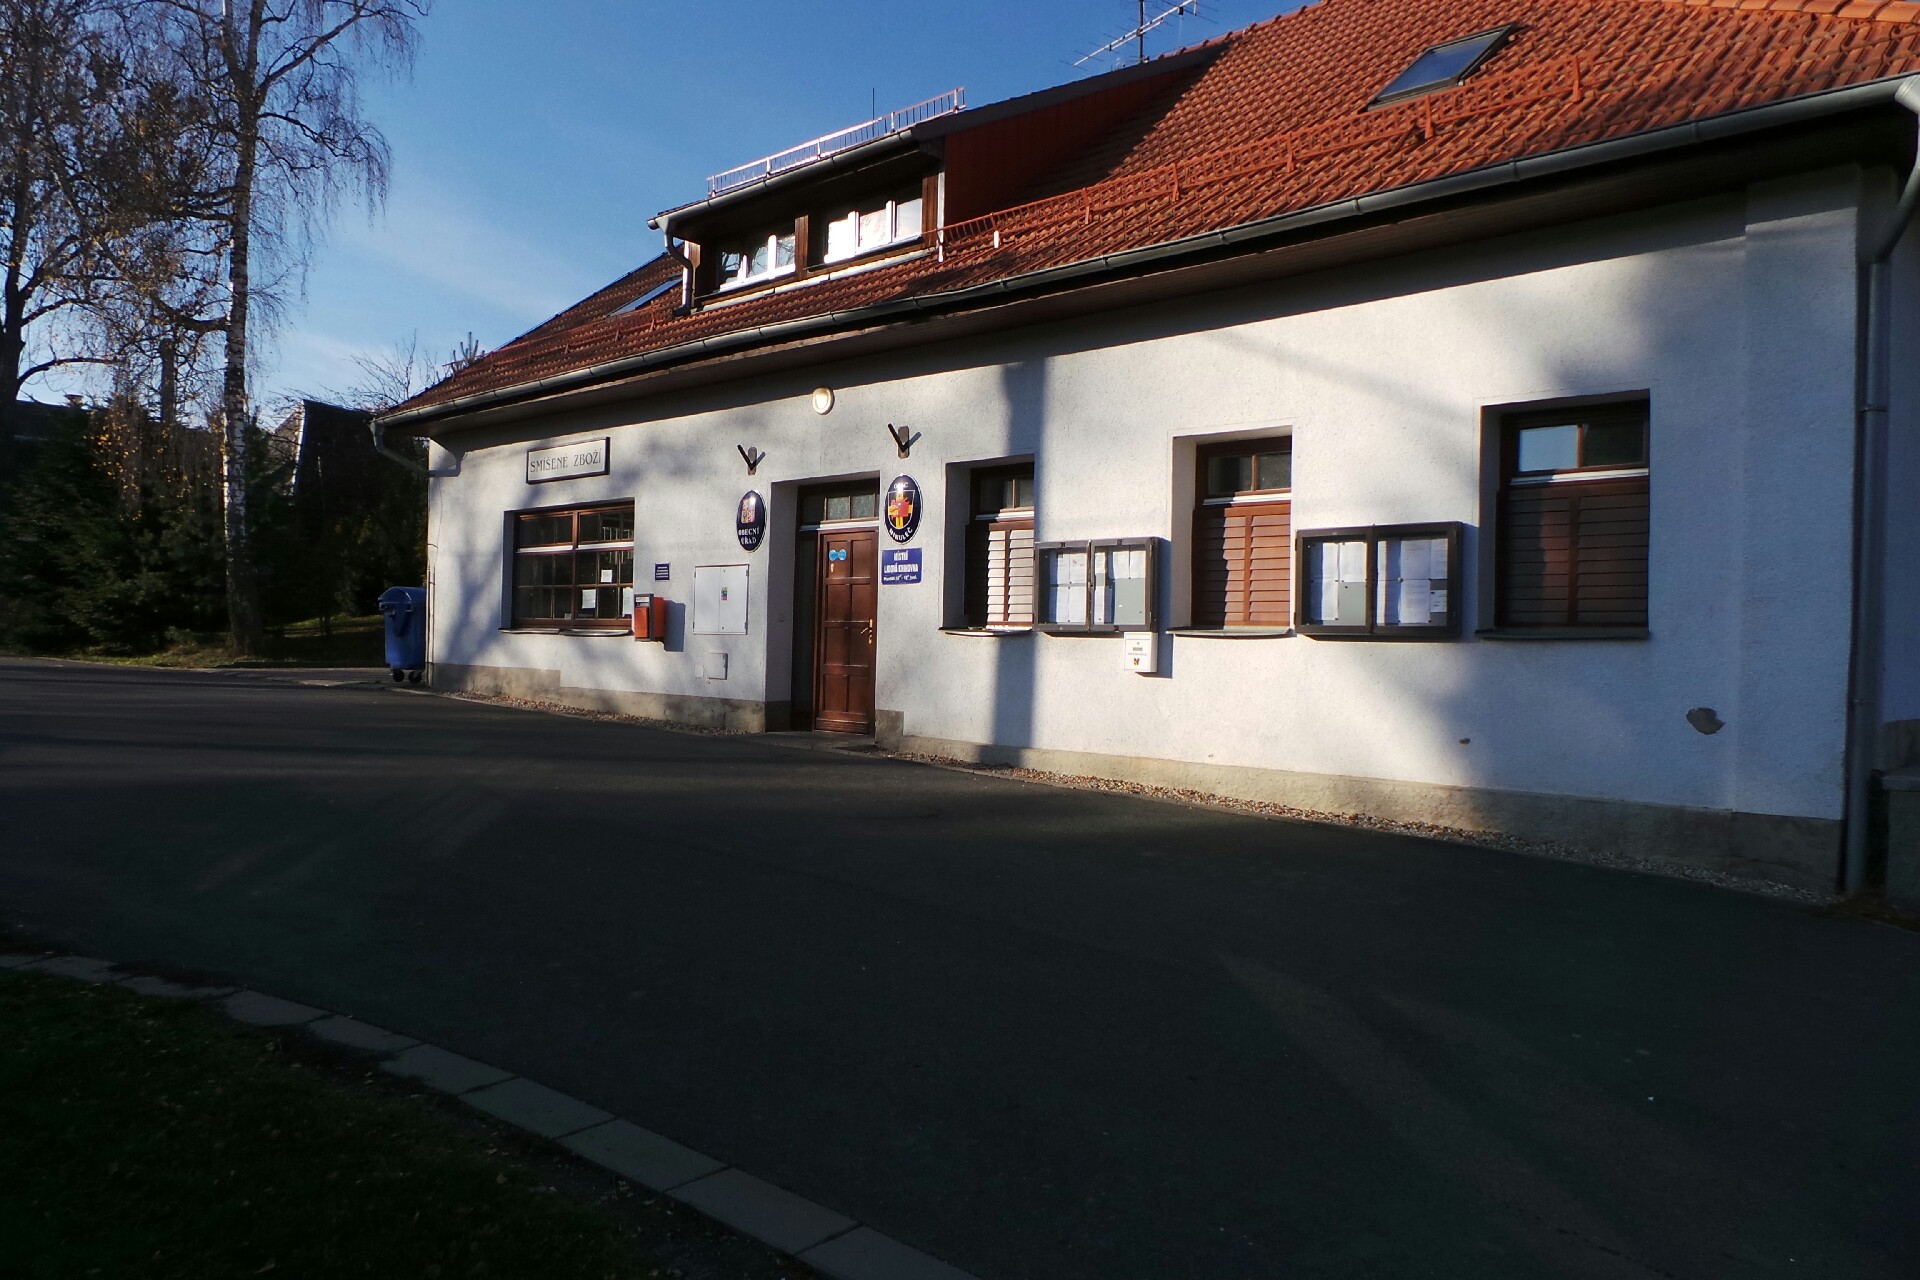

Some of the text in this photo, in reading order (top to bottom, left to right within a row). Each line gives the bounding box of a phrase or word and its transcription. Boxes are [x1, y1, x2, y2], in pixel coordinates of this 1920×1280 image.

[530, 448, 602, 473] SMÍŠENÉ ZBOŽÍ
[738, 526, 760, 536] OBECNÍ
